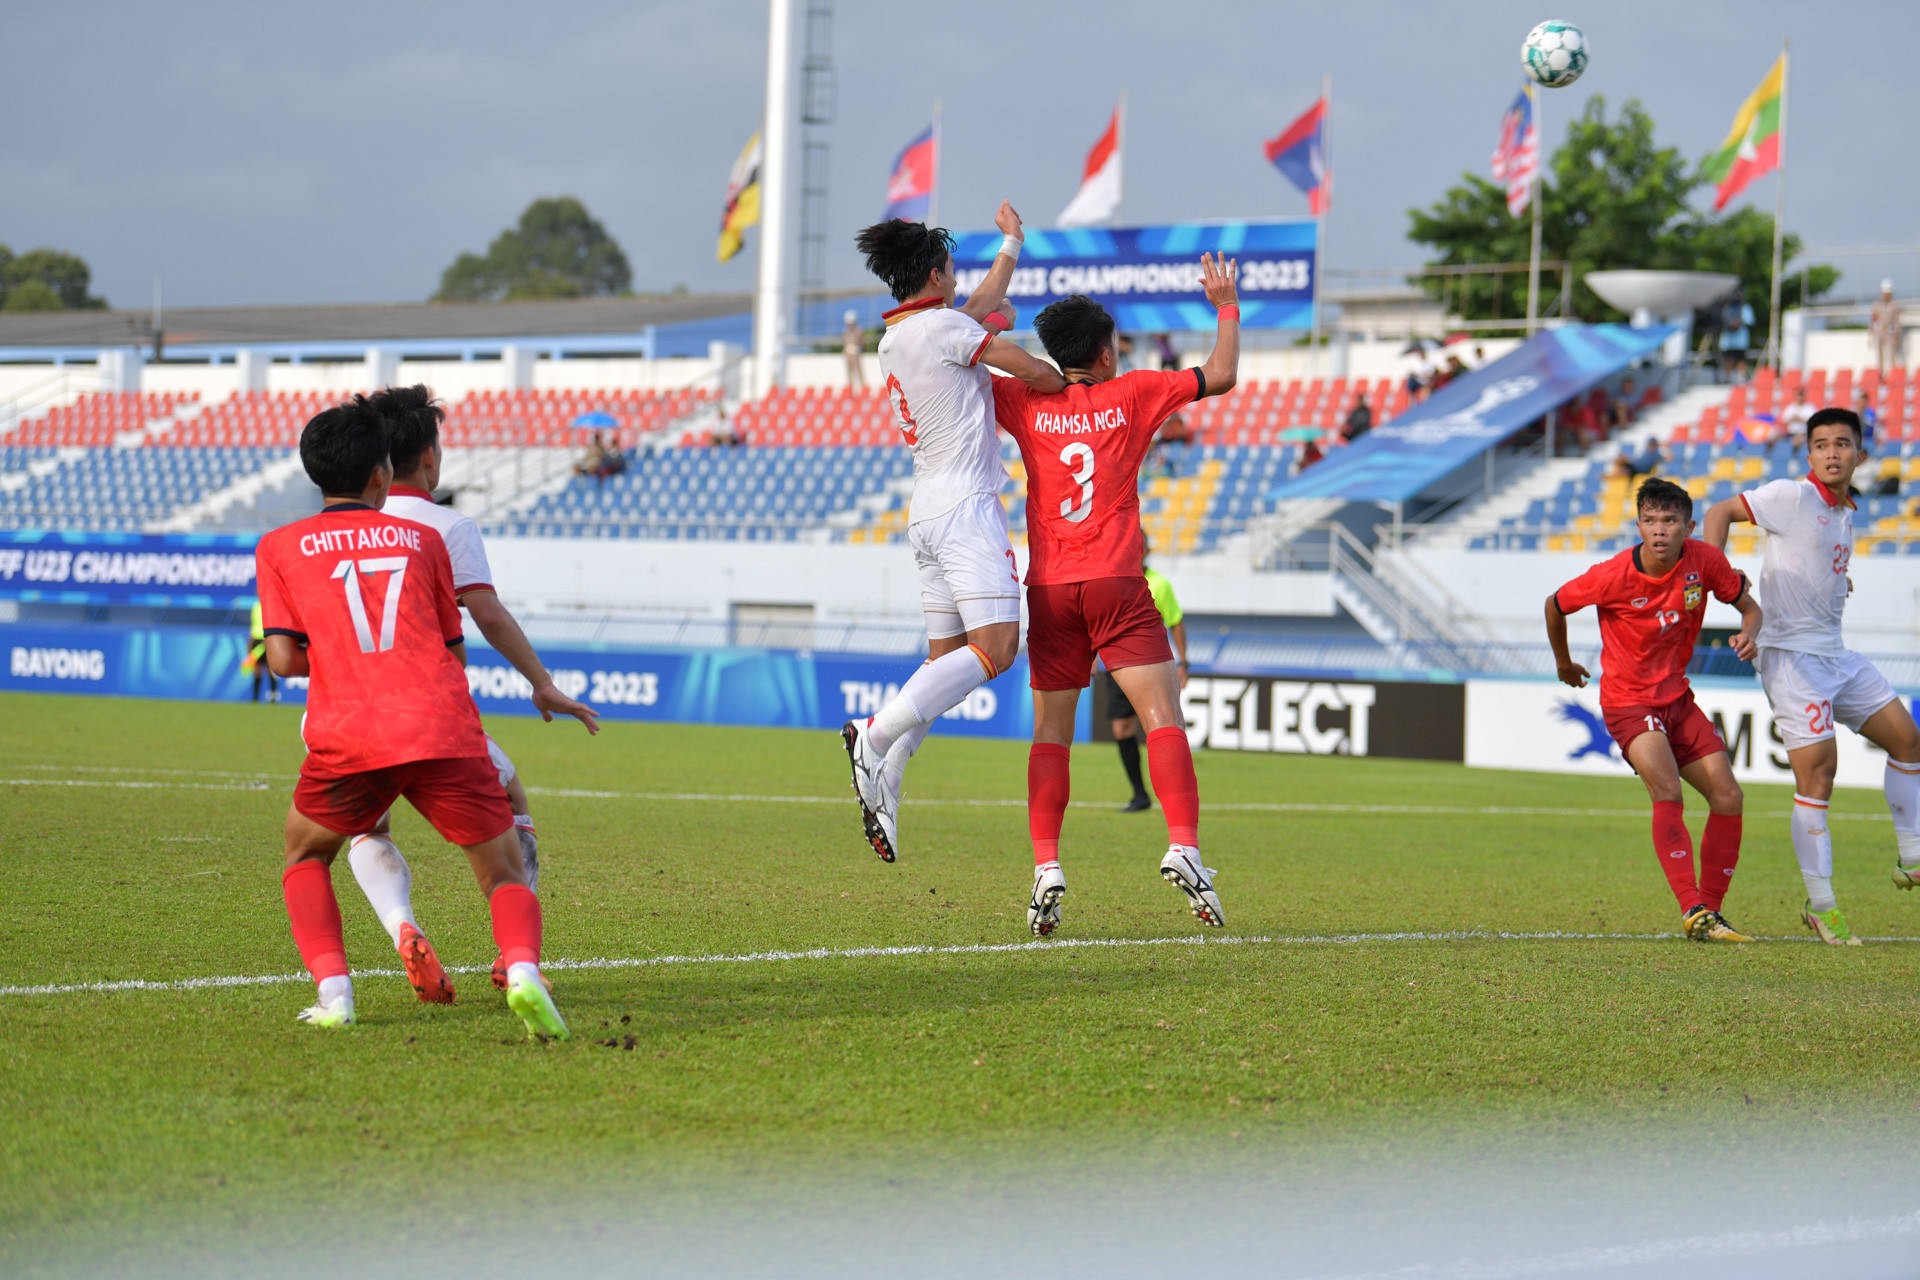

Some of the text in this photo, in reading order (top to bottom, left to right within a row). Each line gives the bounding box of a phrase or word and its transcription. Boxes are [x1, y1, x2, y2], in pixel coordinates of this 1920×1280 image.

[955, 259, 1311, 297] AF 23 CHAMPIONS 2023
[1035, 407, 1127, 435] KHAMSA NGA
[1060, 442, 1095, 522] 3
[300, 526, 421, 557] CHITTAKONE
[24, 549, 73, 582] U23
[72, 550, 257, 586] CHAMPIONSHIP
[330, 556, 409, 654] 17
[11, 647, 105, 680] RAYONG
[589, 670, 660, 706] 2023
[840, 680, 998, 721] THAND
[1180, 677, 1376, 757] SELECT
[1805, 700, 1834, 735] 22
